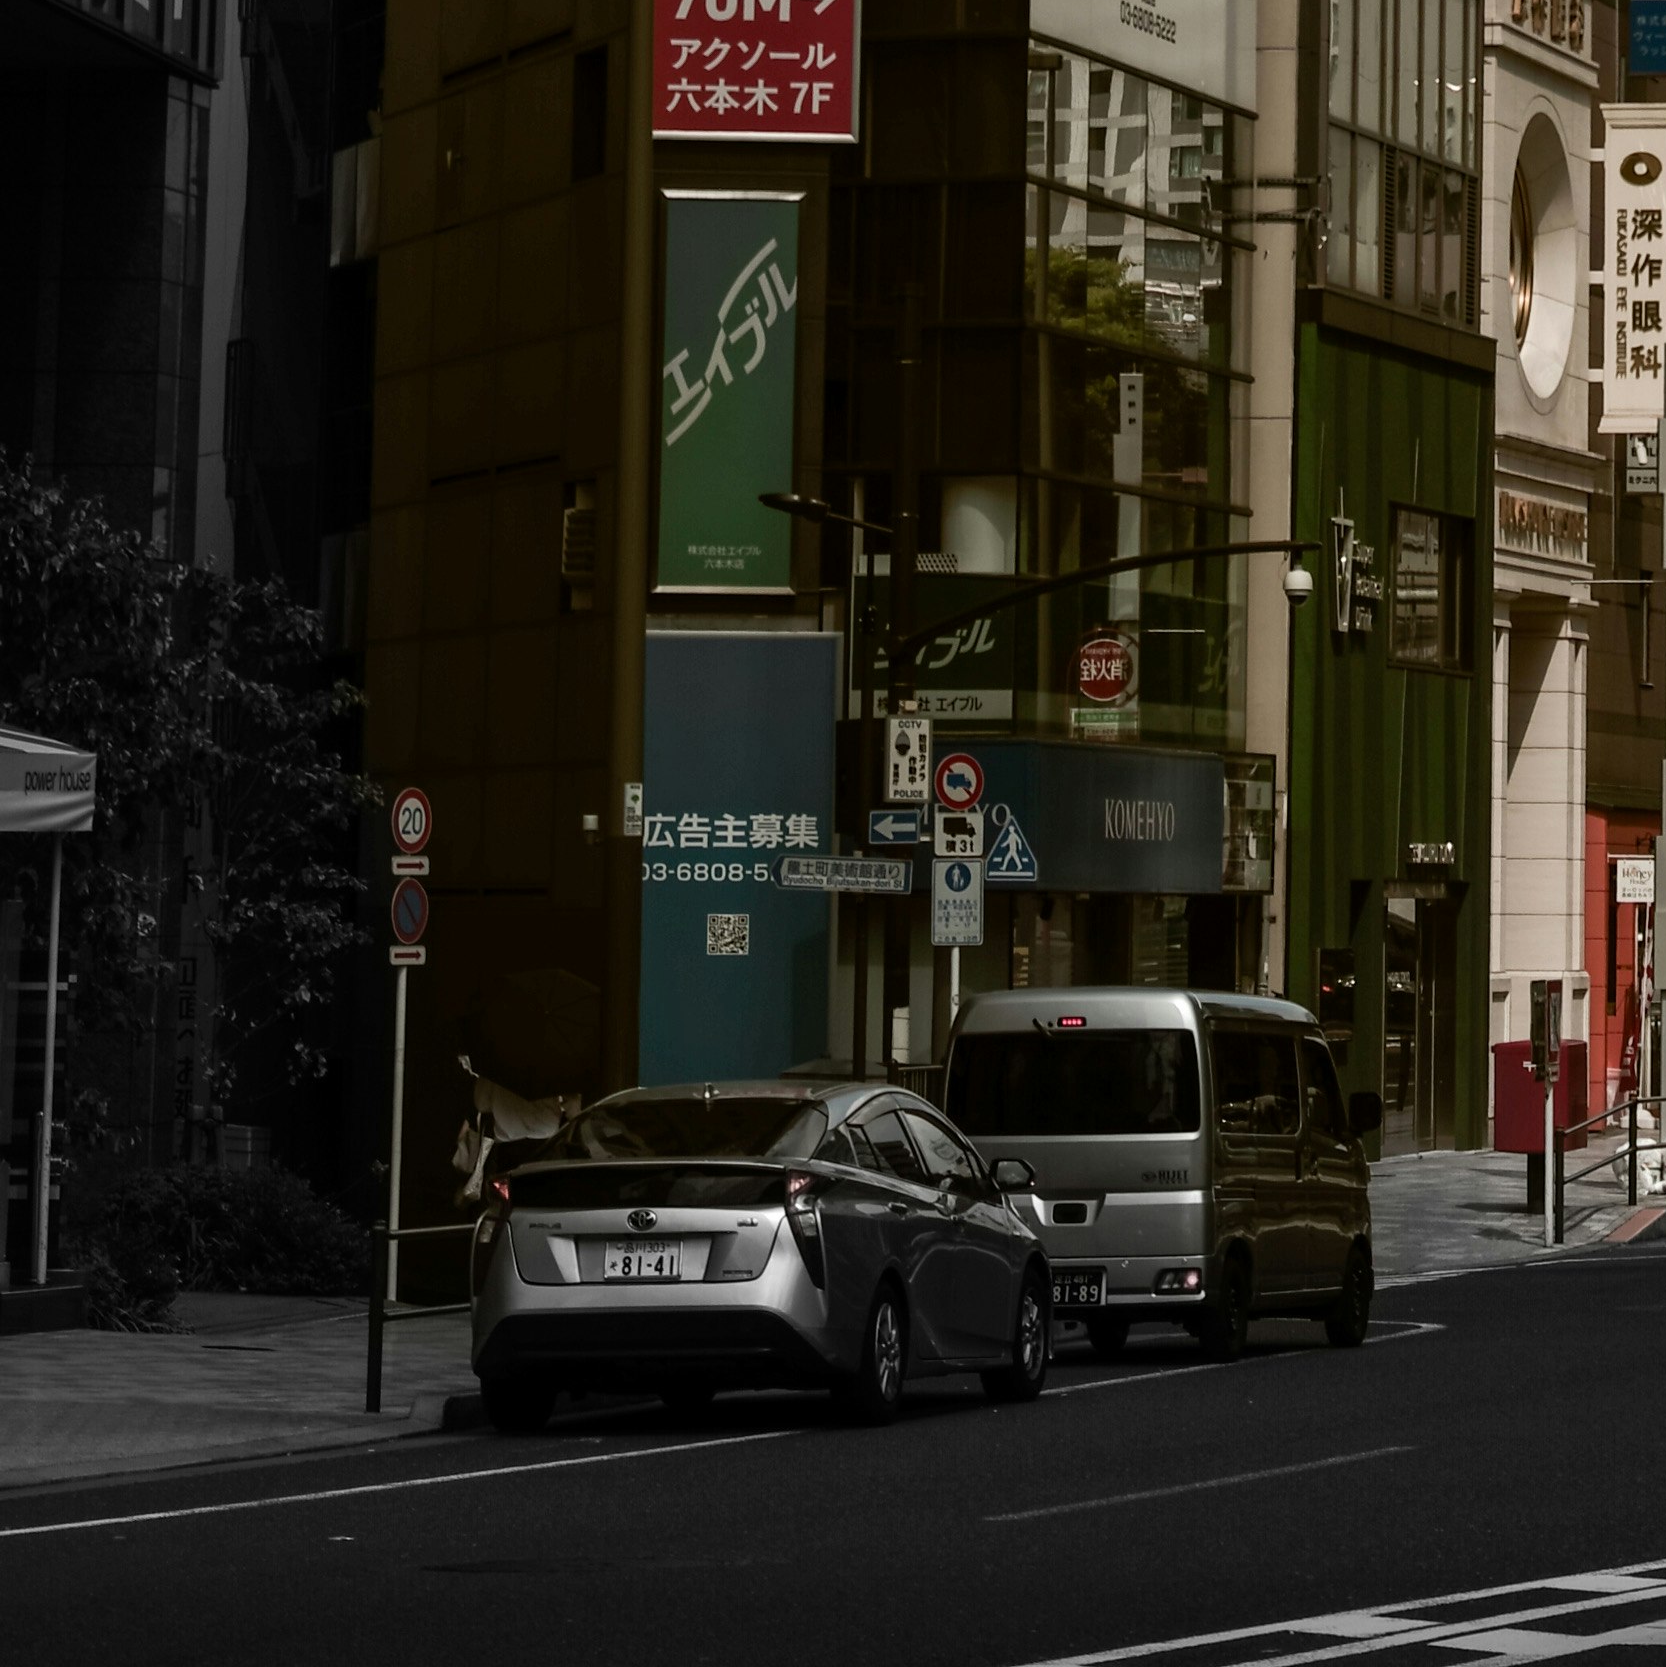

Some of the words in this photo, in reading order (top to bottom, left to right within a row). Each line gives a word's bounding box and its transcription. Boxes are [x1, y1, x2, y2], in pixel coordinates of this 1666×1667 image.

[1120, 0, 1177, 45] 03-6808-5222
[669, 37, 837, 71] アクソール
[666, 78, 778, 116] 六本木
[790, 81, 835, 115] 7F
[1616, 208, 1628, 277] FUKASAKU
[1616, 286, 1627, 312] EYE
[1631, 207, 1663, 380] 深作眼科
[662, 262, 798, 417] エイブル
[1615, 321, 1627, 379] INSTITUTE
[687, 543, 762, 556] 株式会社エイブル
[936, 696, 983, 712] エイブル
[898, 720, 922, 729] CCTV
[908, 756, 917, 785] 作動中
[918, 733, 927, 782] 防犯カメラ
[25, 771, 57, 796] power
[59, 765, 91, 791] house
[893, 790, 924, 798] POLICE
[401, 807, 423, 836] 20
[642, 812, 819, 850] 広告主募集
[1104, 796, 1176, 843] KOMEHYO
[783, 875, 824, 887] Ryudocho
[826, 877, 893, 889] Bijutsukan-dori
[1158, 1170, 1188, 1181] HIJET
[621, 1254, 674, 1276] 81-41
